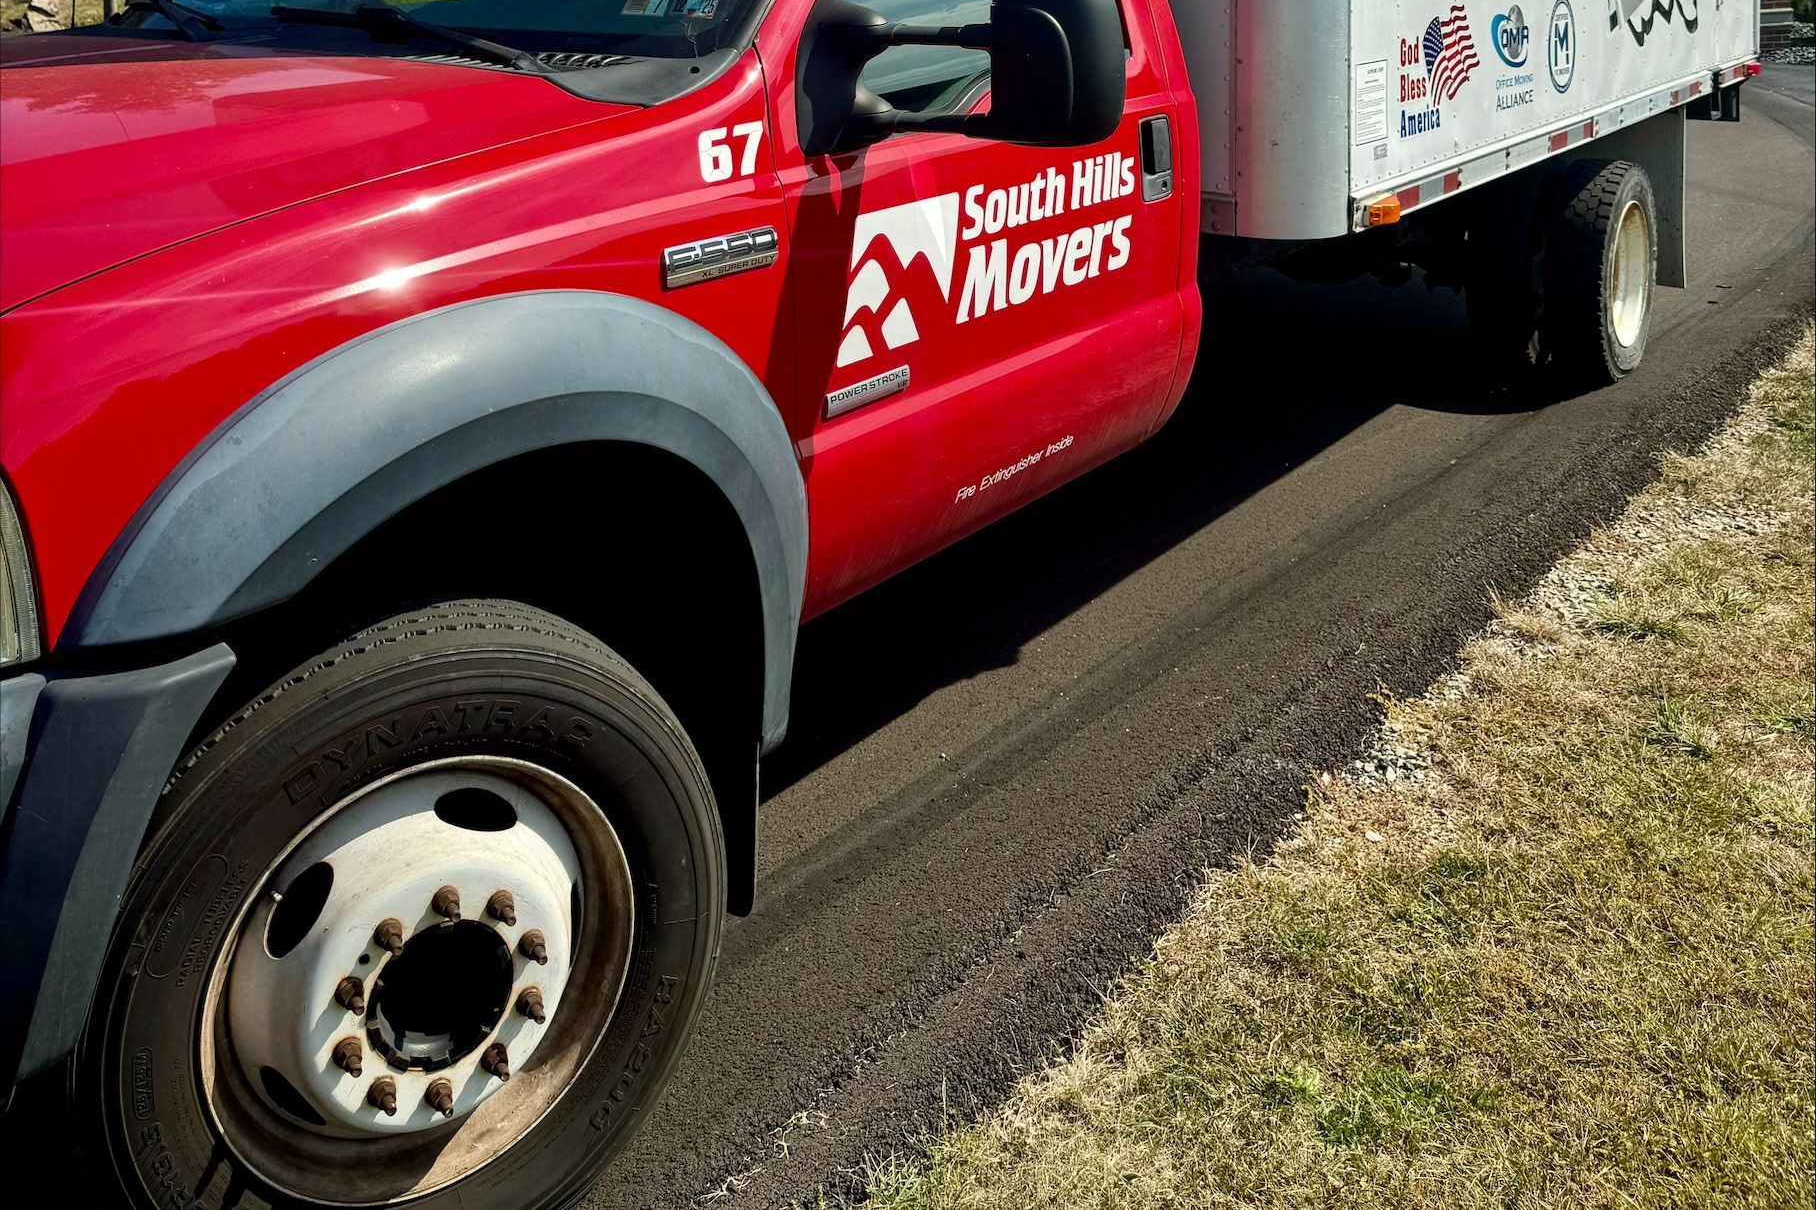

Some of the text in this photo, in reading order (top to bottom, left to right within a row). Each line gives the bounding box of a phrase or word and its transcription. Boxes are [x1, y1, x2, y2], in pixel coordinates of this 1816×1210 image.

[1400, 37, 1419, 67] God
[1501, 25, 1529, 49] OMA
[1400, 74, 1427, 103] Bless
[1496, 78, 1514, 90] OFFICE
[1496, 90, 1534, 112] ALLIANCE
[1400, 105, 1441, 138] America
[697, 121, 764, 183] 67
[962, 152, 1135, 241] South Hills
[702, 255, 776, 278] XL SUPER DUTY
[955, 214, 1133, 324] Movers
[955, 435, 1074, 504] Fire Extinguisher Inside
